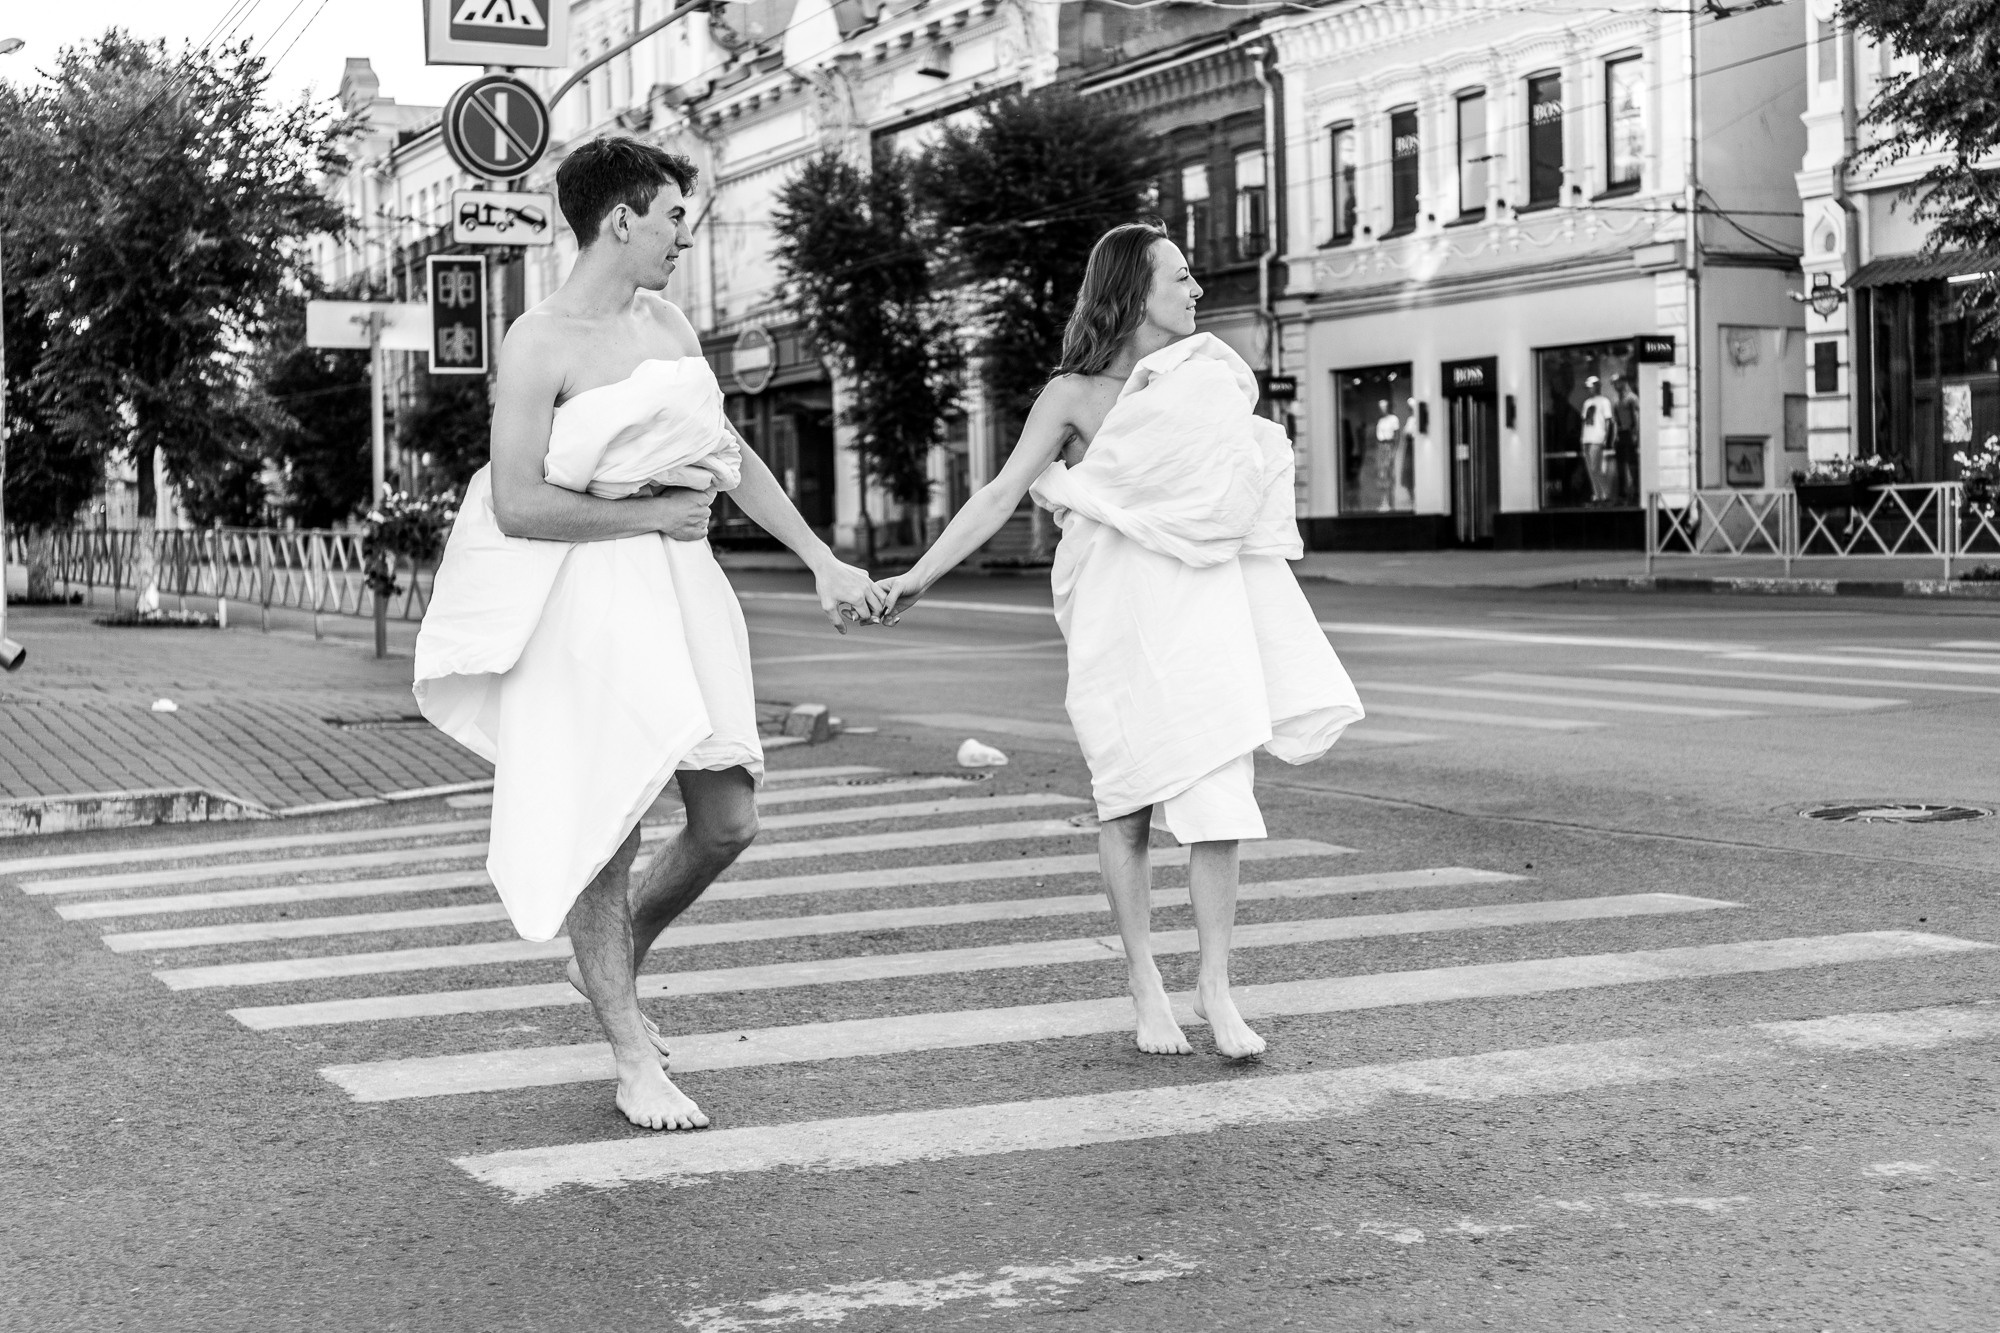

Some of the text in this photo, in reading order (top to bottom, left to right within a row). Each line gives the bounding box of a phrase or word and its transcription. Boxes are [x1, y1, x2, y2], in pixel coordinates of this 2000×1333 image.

[1533, 100, 1561, 120] BOS
[1395, 133, 1419, 151] BOS
[1645, 341, 1672, 352] BOSS
[1453, 366, 1484, 383] BOSS
